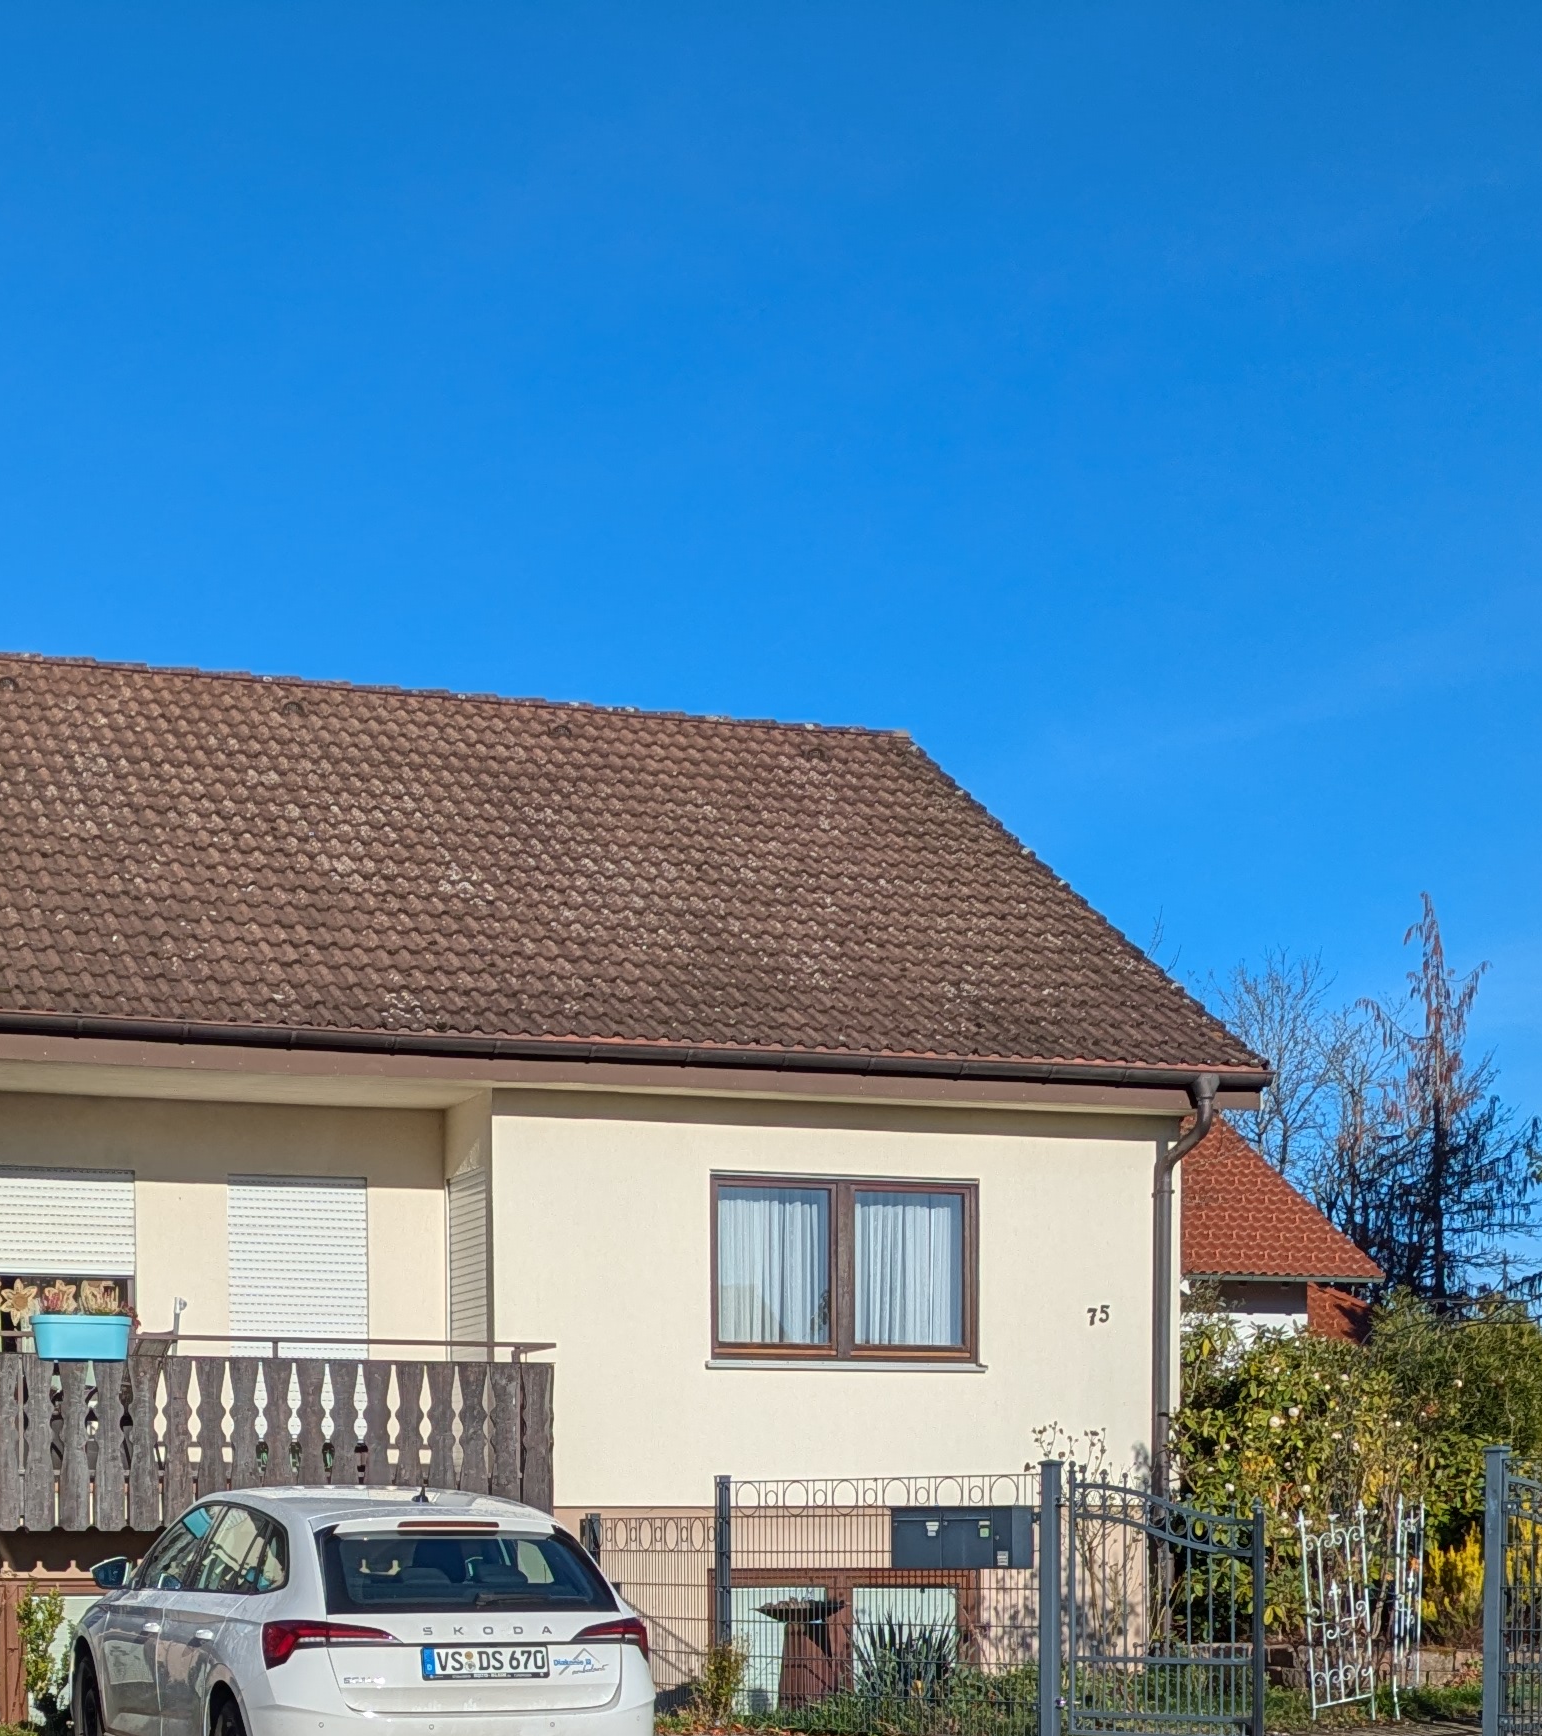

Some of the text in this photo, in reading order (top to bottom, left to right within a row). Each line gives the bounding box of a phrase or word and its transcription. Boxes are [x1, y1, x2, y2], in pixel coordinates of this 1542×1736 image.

[1086, 1304, 1111, 1327] 75
[436, 1649, 546, 1672] VS DS 670
